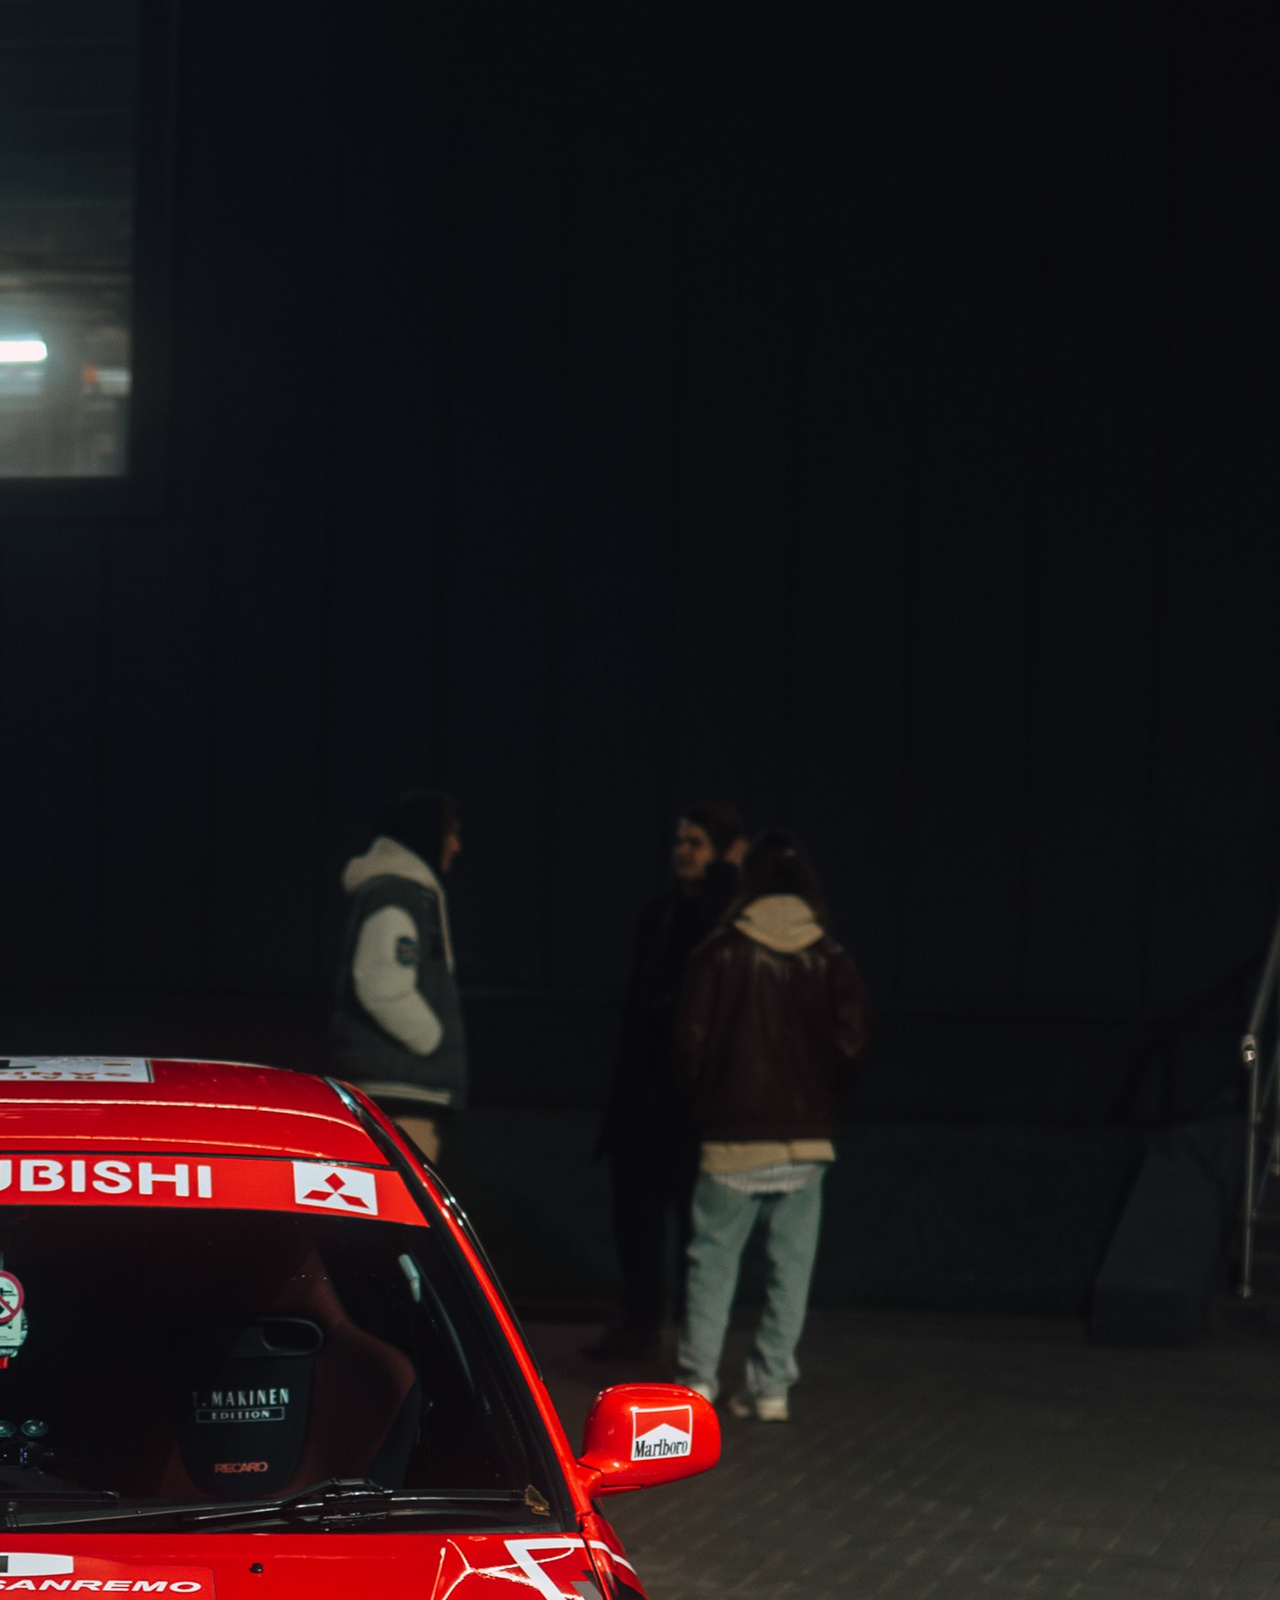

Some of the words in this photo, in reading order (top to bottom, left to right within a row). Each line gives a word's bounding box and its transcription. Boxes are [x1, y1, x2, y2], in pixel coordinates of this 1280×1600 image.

[211, 1410, 270, 1420] EDITION
[634, 1438, 688, 1459] Marlboro
[214, 1462, 269, 1474] RECARO
